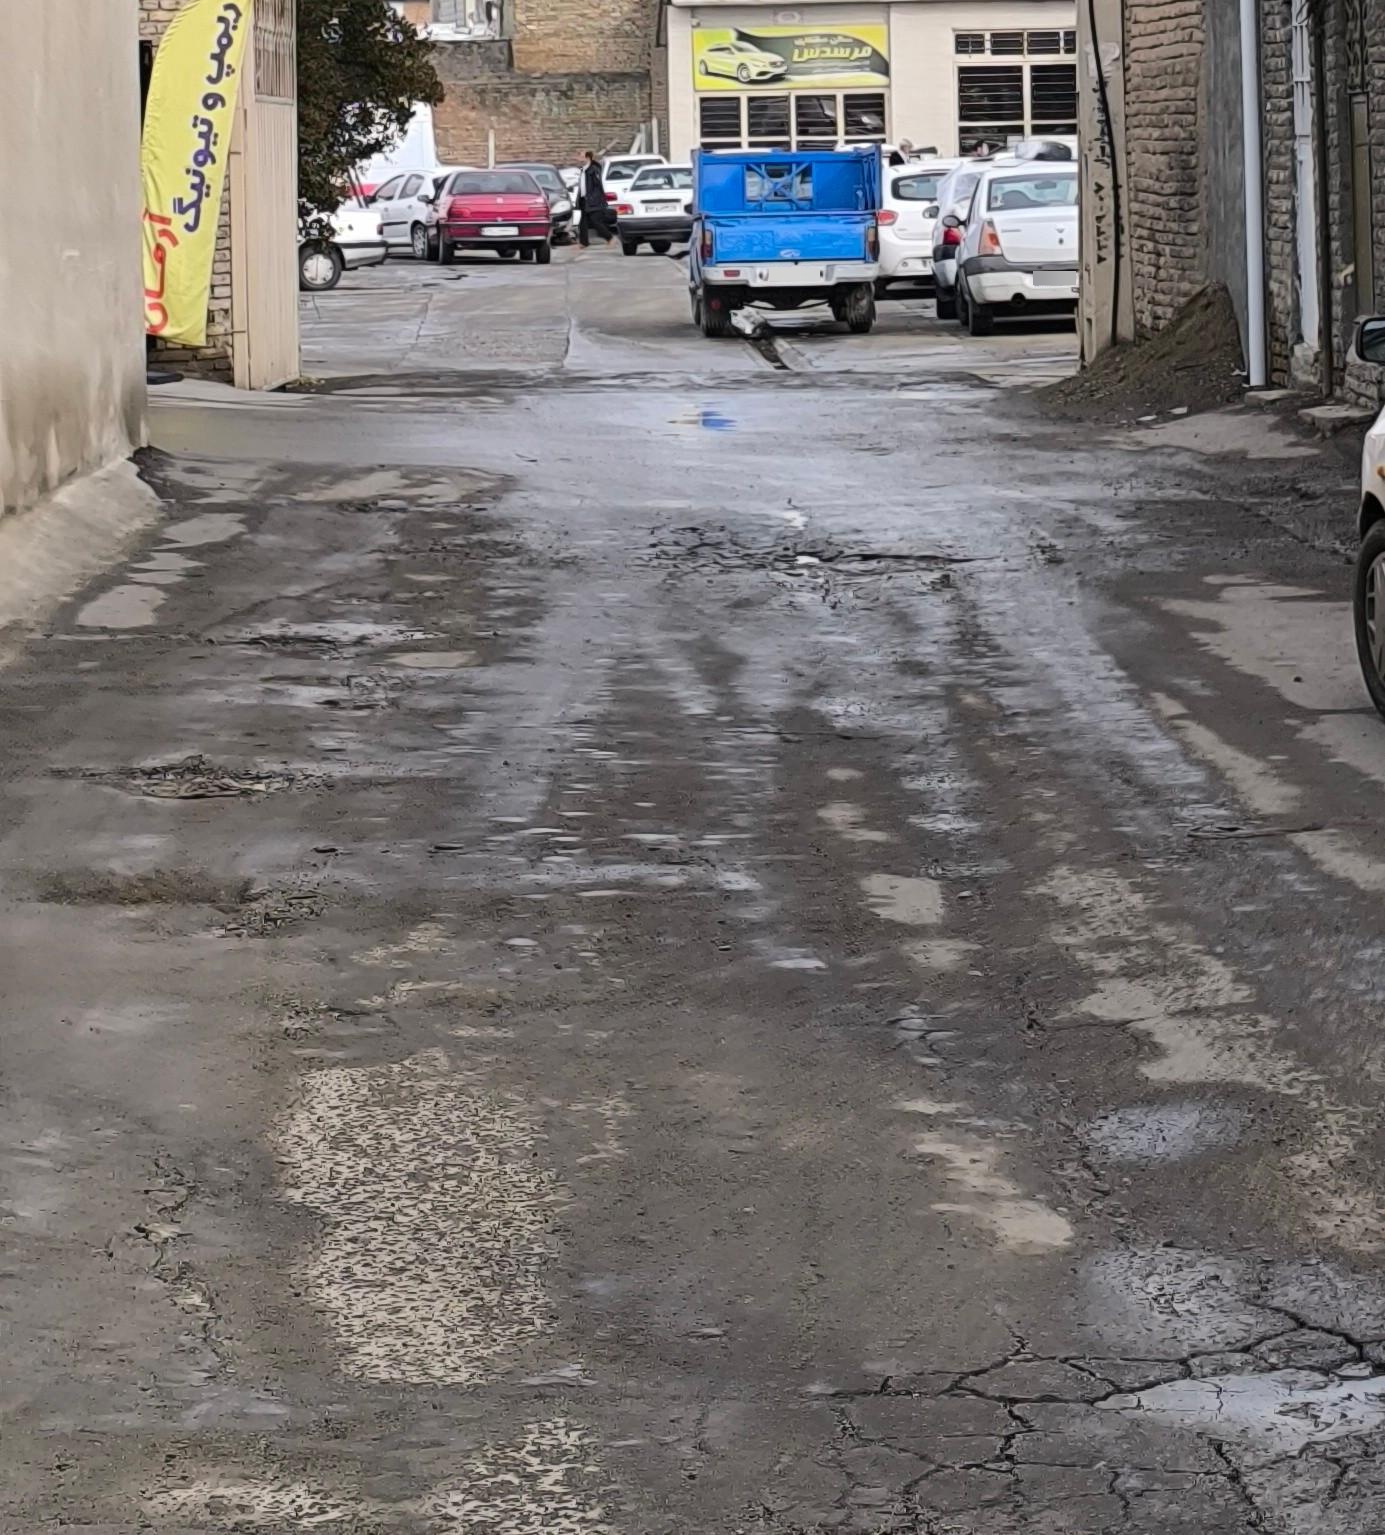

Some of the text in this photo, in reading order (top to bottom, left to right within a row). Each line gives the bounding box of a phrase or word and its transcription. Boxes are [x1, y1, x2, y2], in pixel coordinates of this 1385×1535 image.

[206, 2, 243, 85] ریمپ
[792, 45, 872, 63] مرسدس
[201, 91, 227, 112] و
